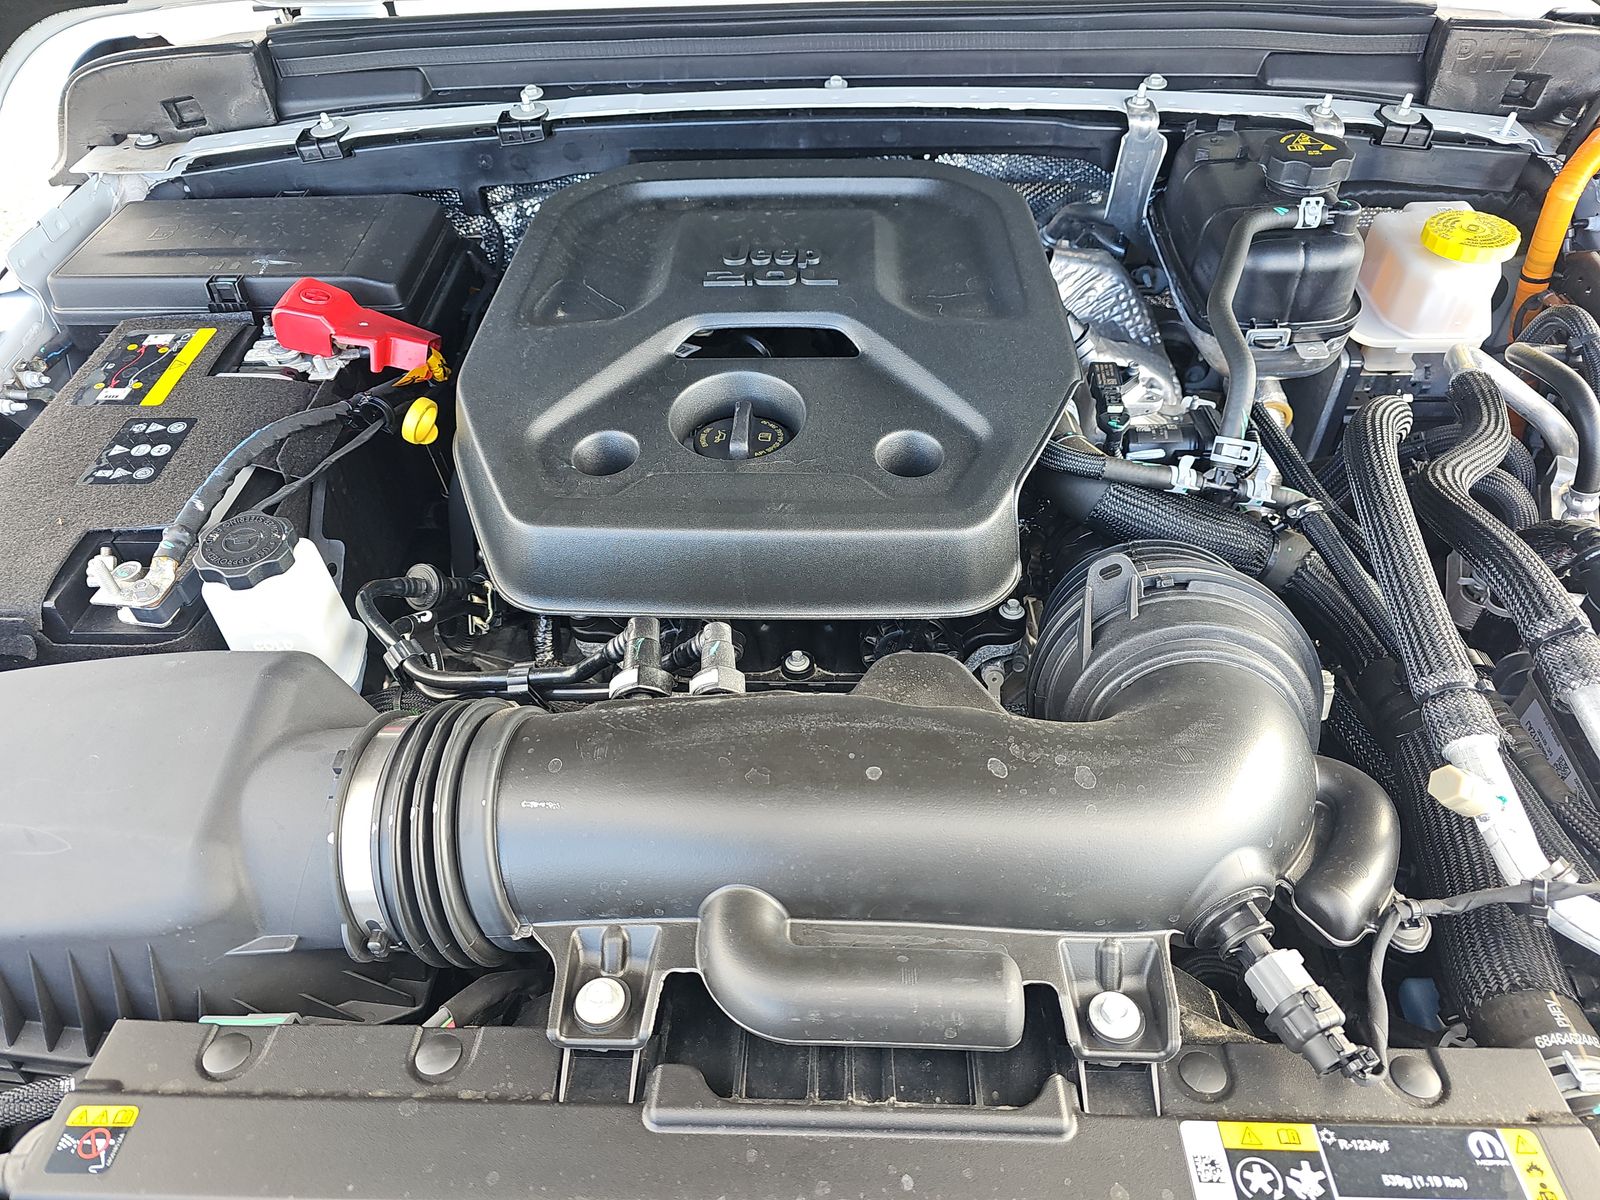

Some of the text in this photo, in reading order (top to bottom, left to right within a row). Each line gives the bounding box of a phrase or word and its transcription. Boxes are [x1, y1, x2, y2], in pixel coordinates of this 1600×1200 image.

[722, 244, 821, 269] Jeep
[703, 268, 839, 287] 2.0L
[222, 514, 264, 528] STEERING
[207, 551, 252, 566] APPROVED
[1543, 998, 1572, 1028] PHEV
[1337, 1138, 1391, 1154] R-1234yf
